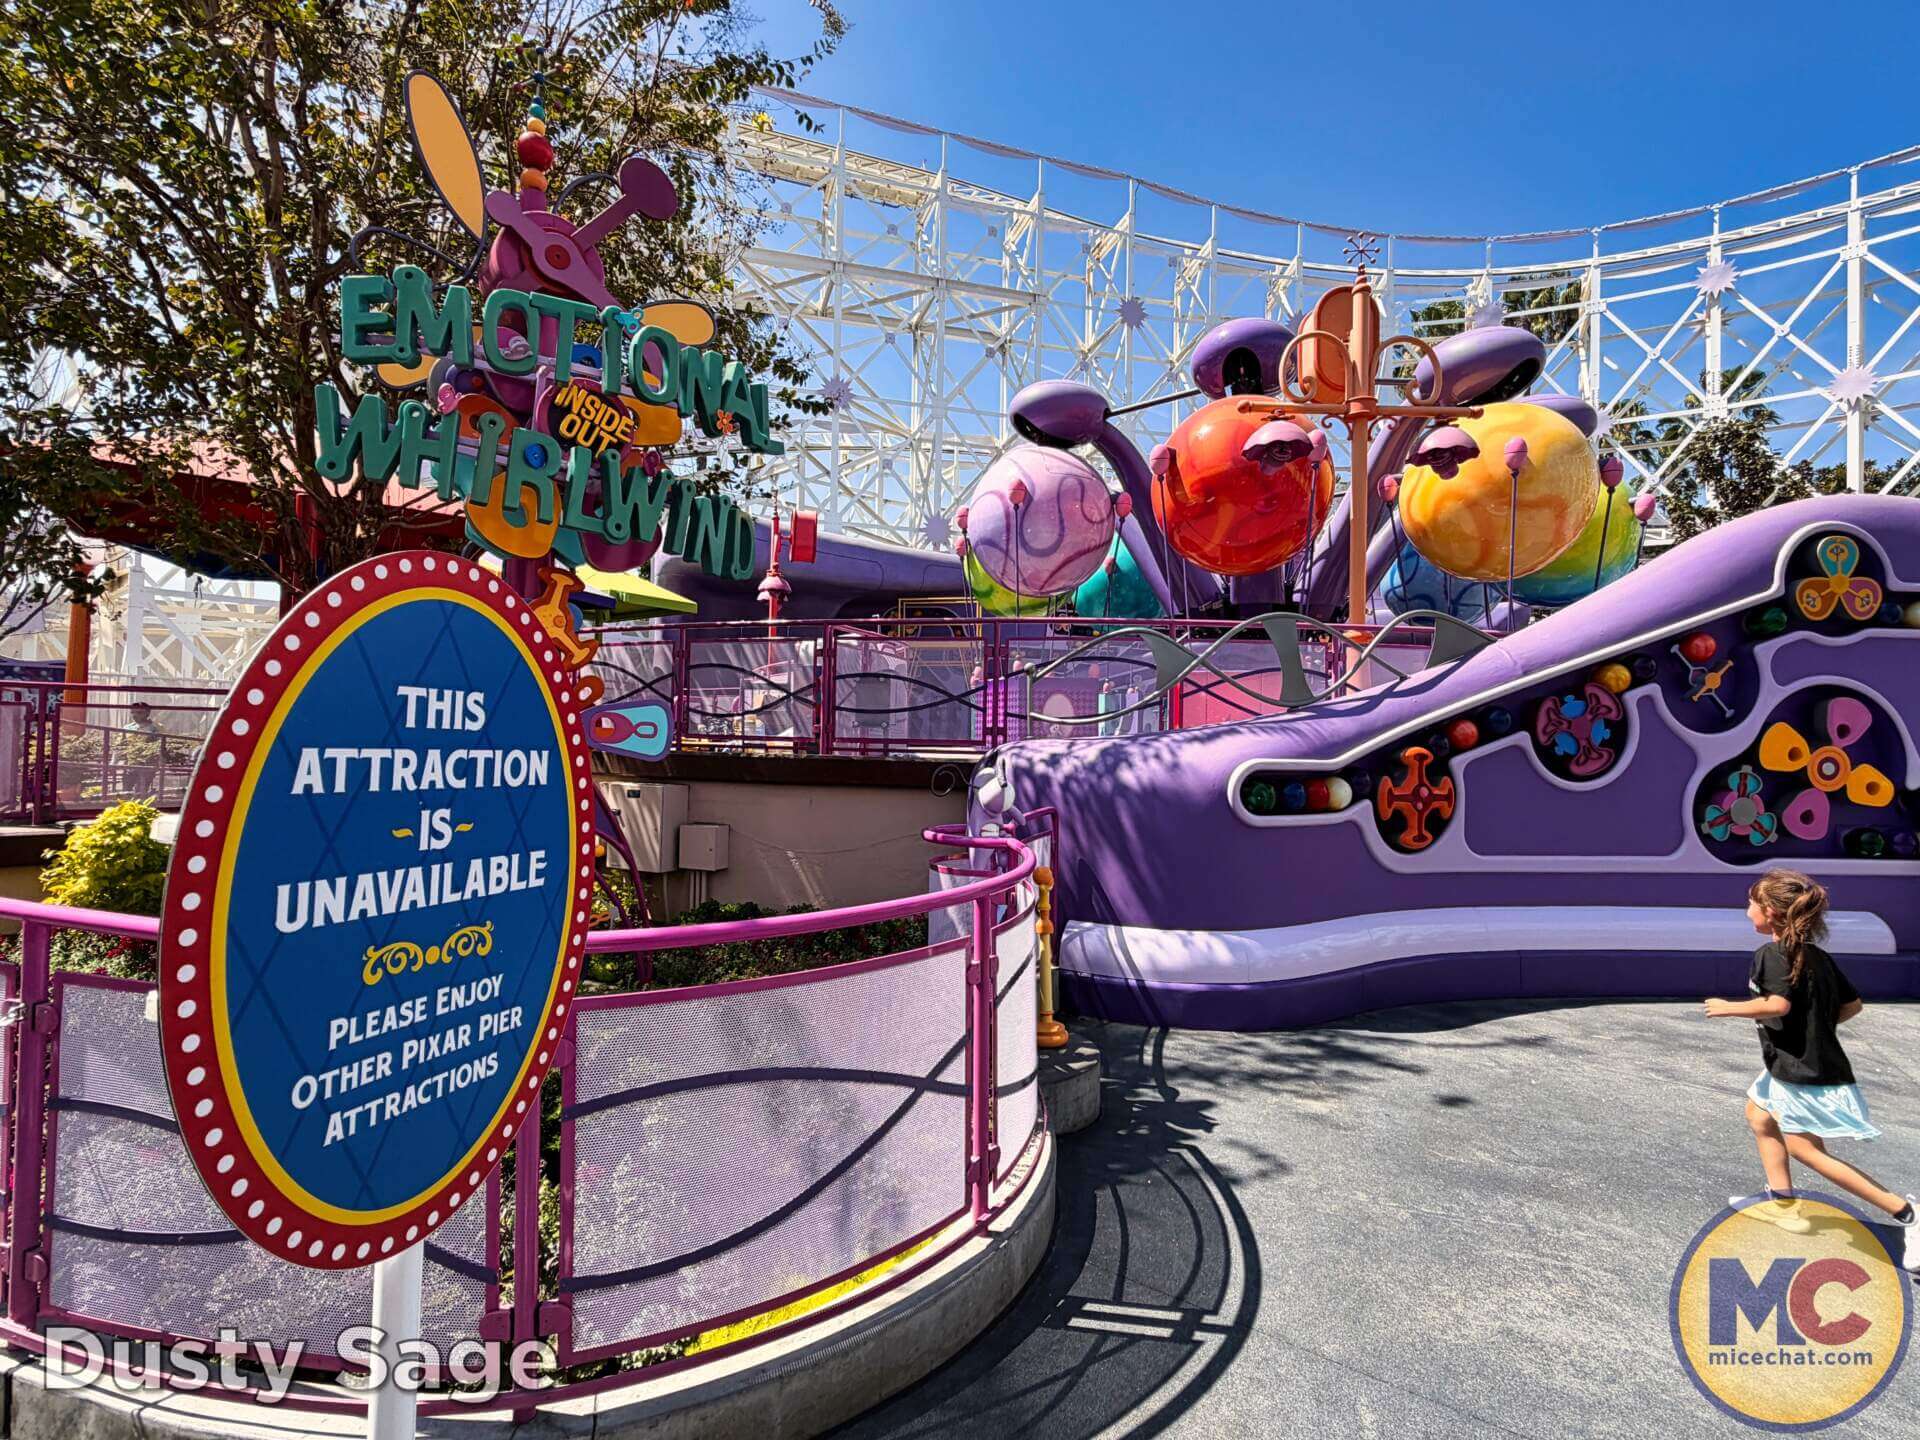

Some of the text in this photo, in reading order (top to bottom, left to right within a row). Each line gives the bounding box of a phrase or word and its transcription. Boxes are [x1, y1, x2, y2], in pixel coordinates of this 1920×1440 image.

[341, 264, 784, 454] EMOTIONAL
[554, 384, 634, 443] INSIDE
[559, 413, 618, 458] OUT
[314, 384, 756, 580] WHIRLWIND
[397, 685, 486, 731] THIS
[291, 747, 550, 794] ATTRACTION
[418, 808, 453, 851] IS
[275, 850, 548, 933] UNAVAILABLE
[328, 973, 504, 1051] PLEASE ENJOY
[291, 1006, 523, 1110] OTHER PIXAR PIER
[322, 1051, 500, 1147] ATTRACTIONS
